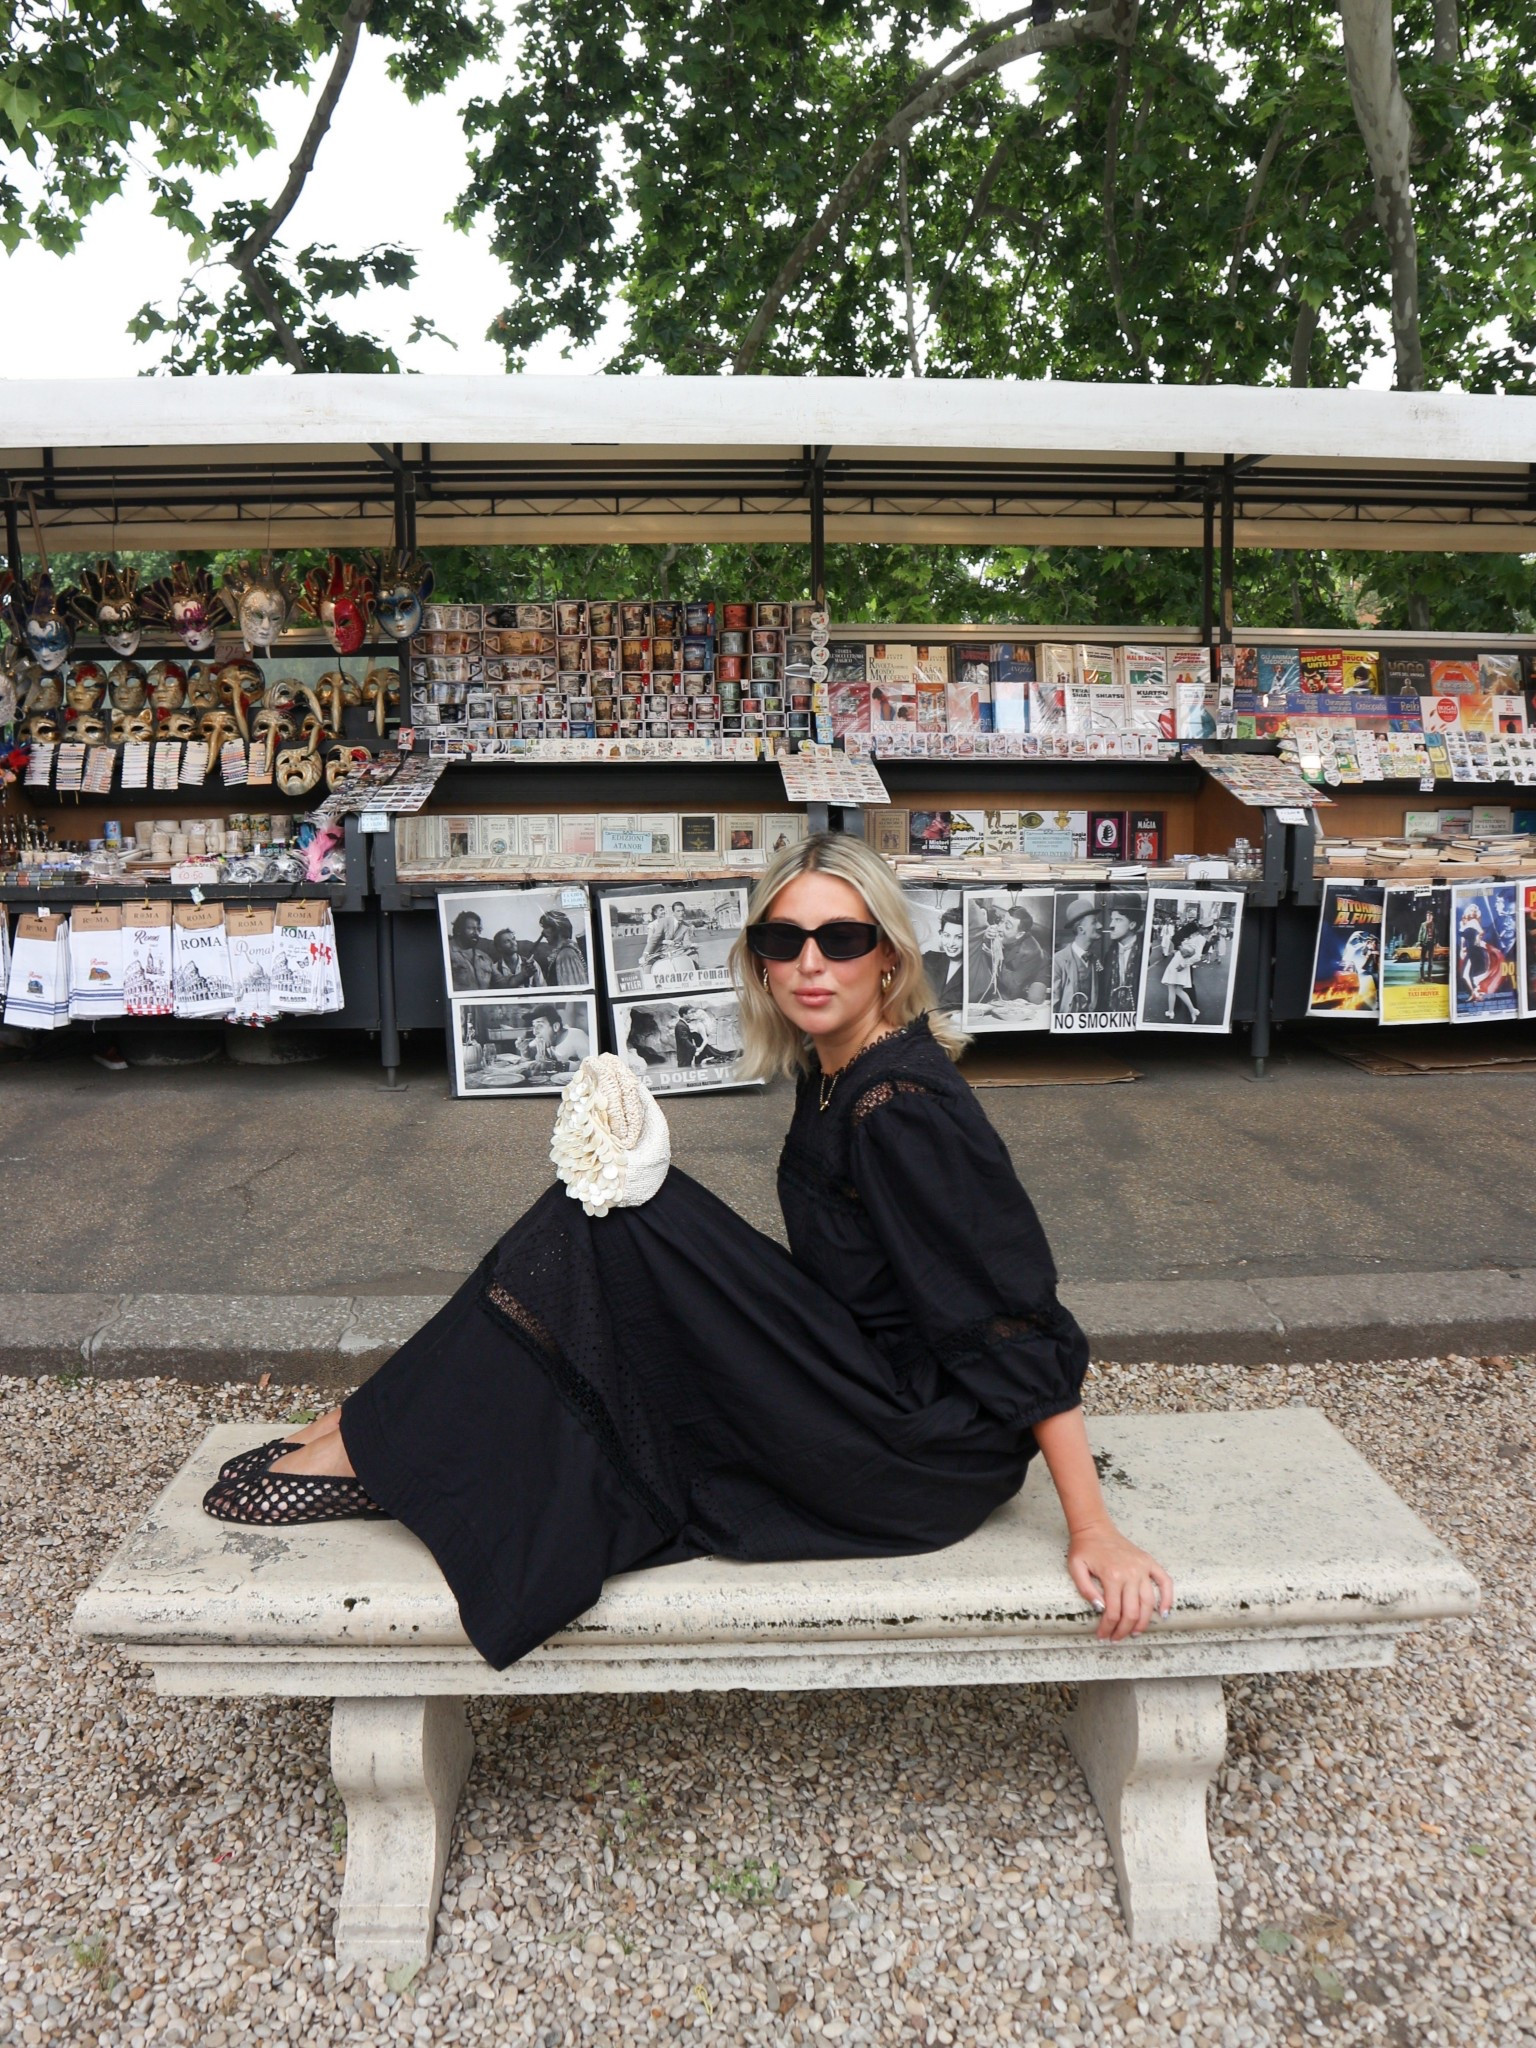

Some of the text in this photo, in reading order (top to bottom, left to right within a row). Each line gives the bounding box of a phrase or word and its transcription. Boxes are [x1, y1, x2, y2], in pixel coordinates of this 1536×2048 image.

[869, 656, 894, 669] RIVOLTA
[1301, 655, 1326, 663] BRUCE
[1307, 660, 1338, 669] UNTOLD
[870, 669, 895, 681] MONDO
[1401, 701, 1420, 712] Reiki
[1137, 820, 1156, 829] MAGIA
[611, 834, 644, 842] EDIZIONI
[613, 842, 643, 850] ATANOR
[186, 913, 212, 922] ROMA
[287, 911, 312, 919] ROMA
[1334, 911, 1350, 925] AL
[238, 920, 264, 928] ROMA
[281, 926, 317, 940] ROMA
[180, 936, 222, 951] ROMA
[234, 940, 271, 964] Roma
[619, 980, 642, 992] WYLER
[1054, 1013, 1074, 1030] NO
[660, 1069, 709, 1085] DOLCE
